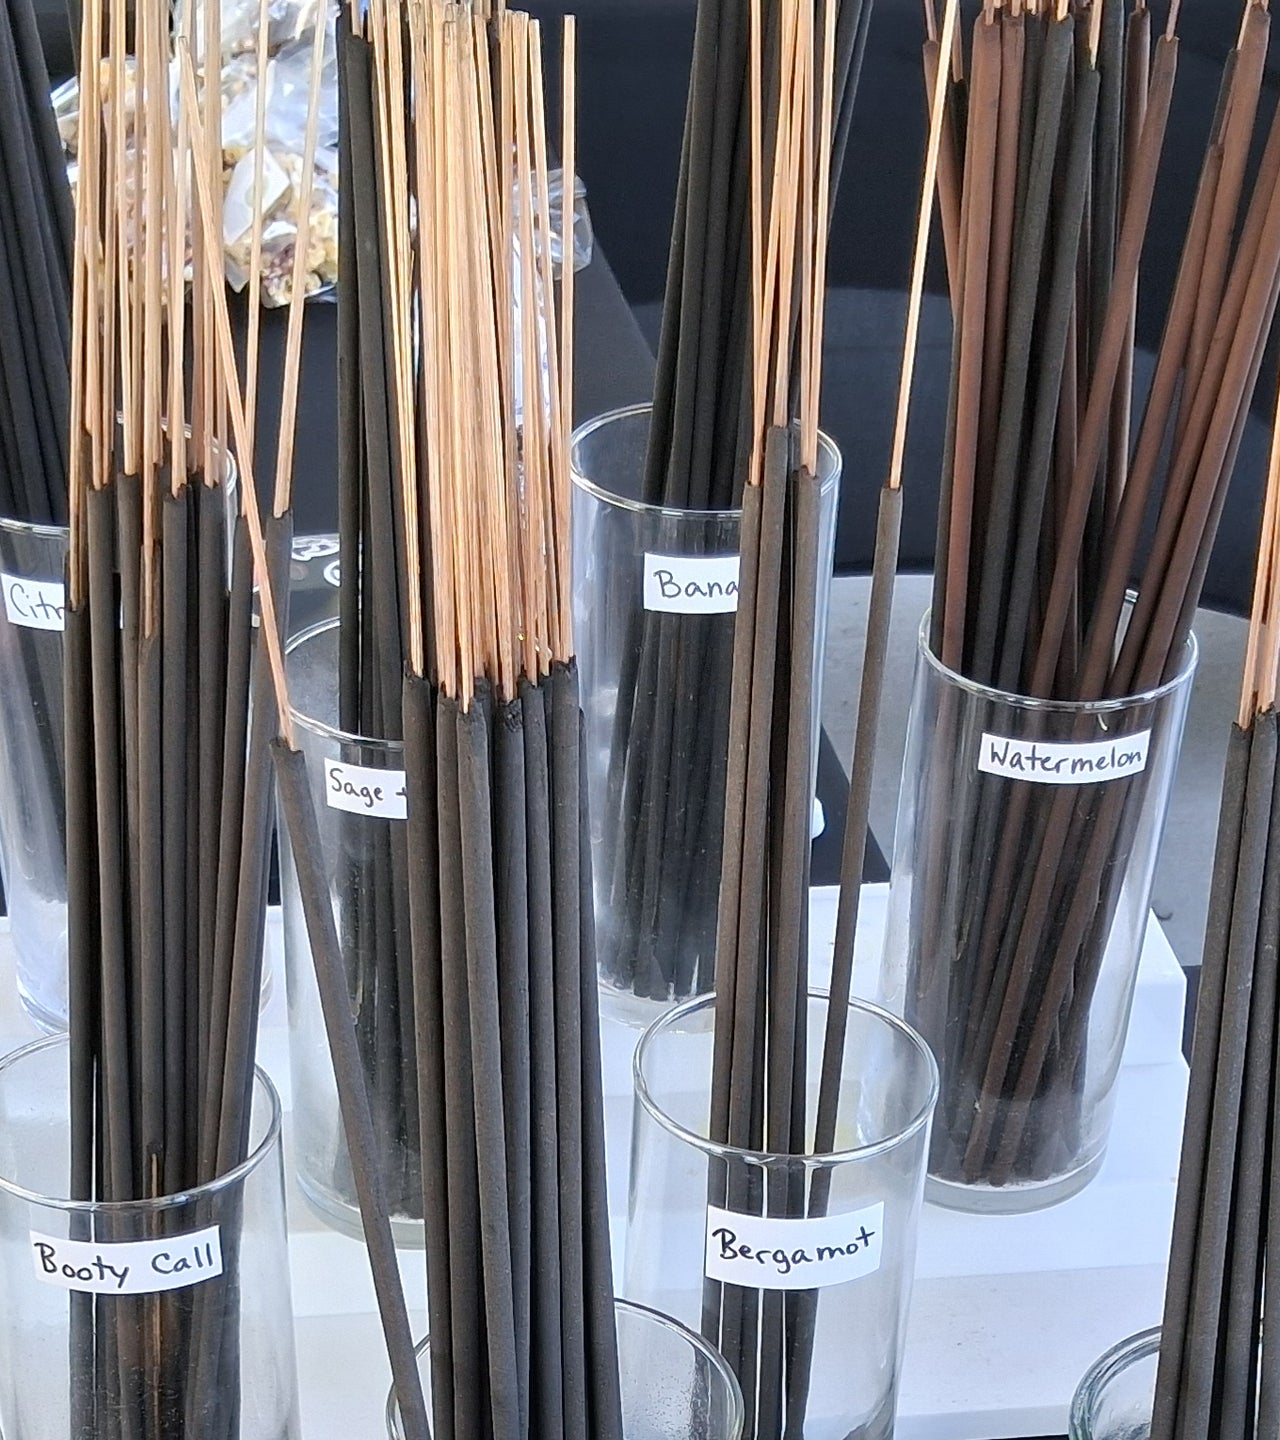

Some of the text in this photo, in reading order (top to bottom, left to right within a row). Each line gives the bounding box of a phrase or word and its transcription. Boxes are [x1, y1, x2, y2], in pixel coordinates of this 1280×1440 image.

[990, 741, 1142, 775] Watermelon
[329, 767, 384, 808] Sage
[33, 1241, 214, 1289] Booty Call
[711, 1225, 876, 1274] Bergamot
